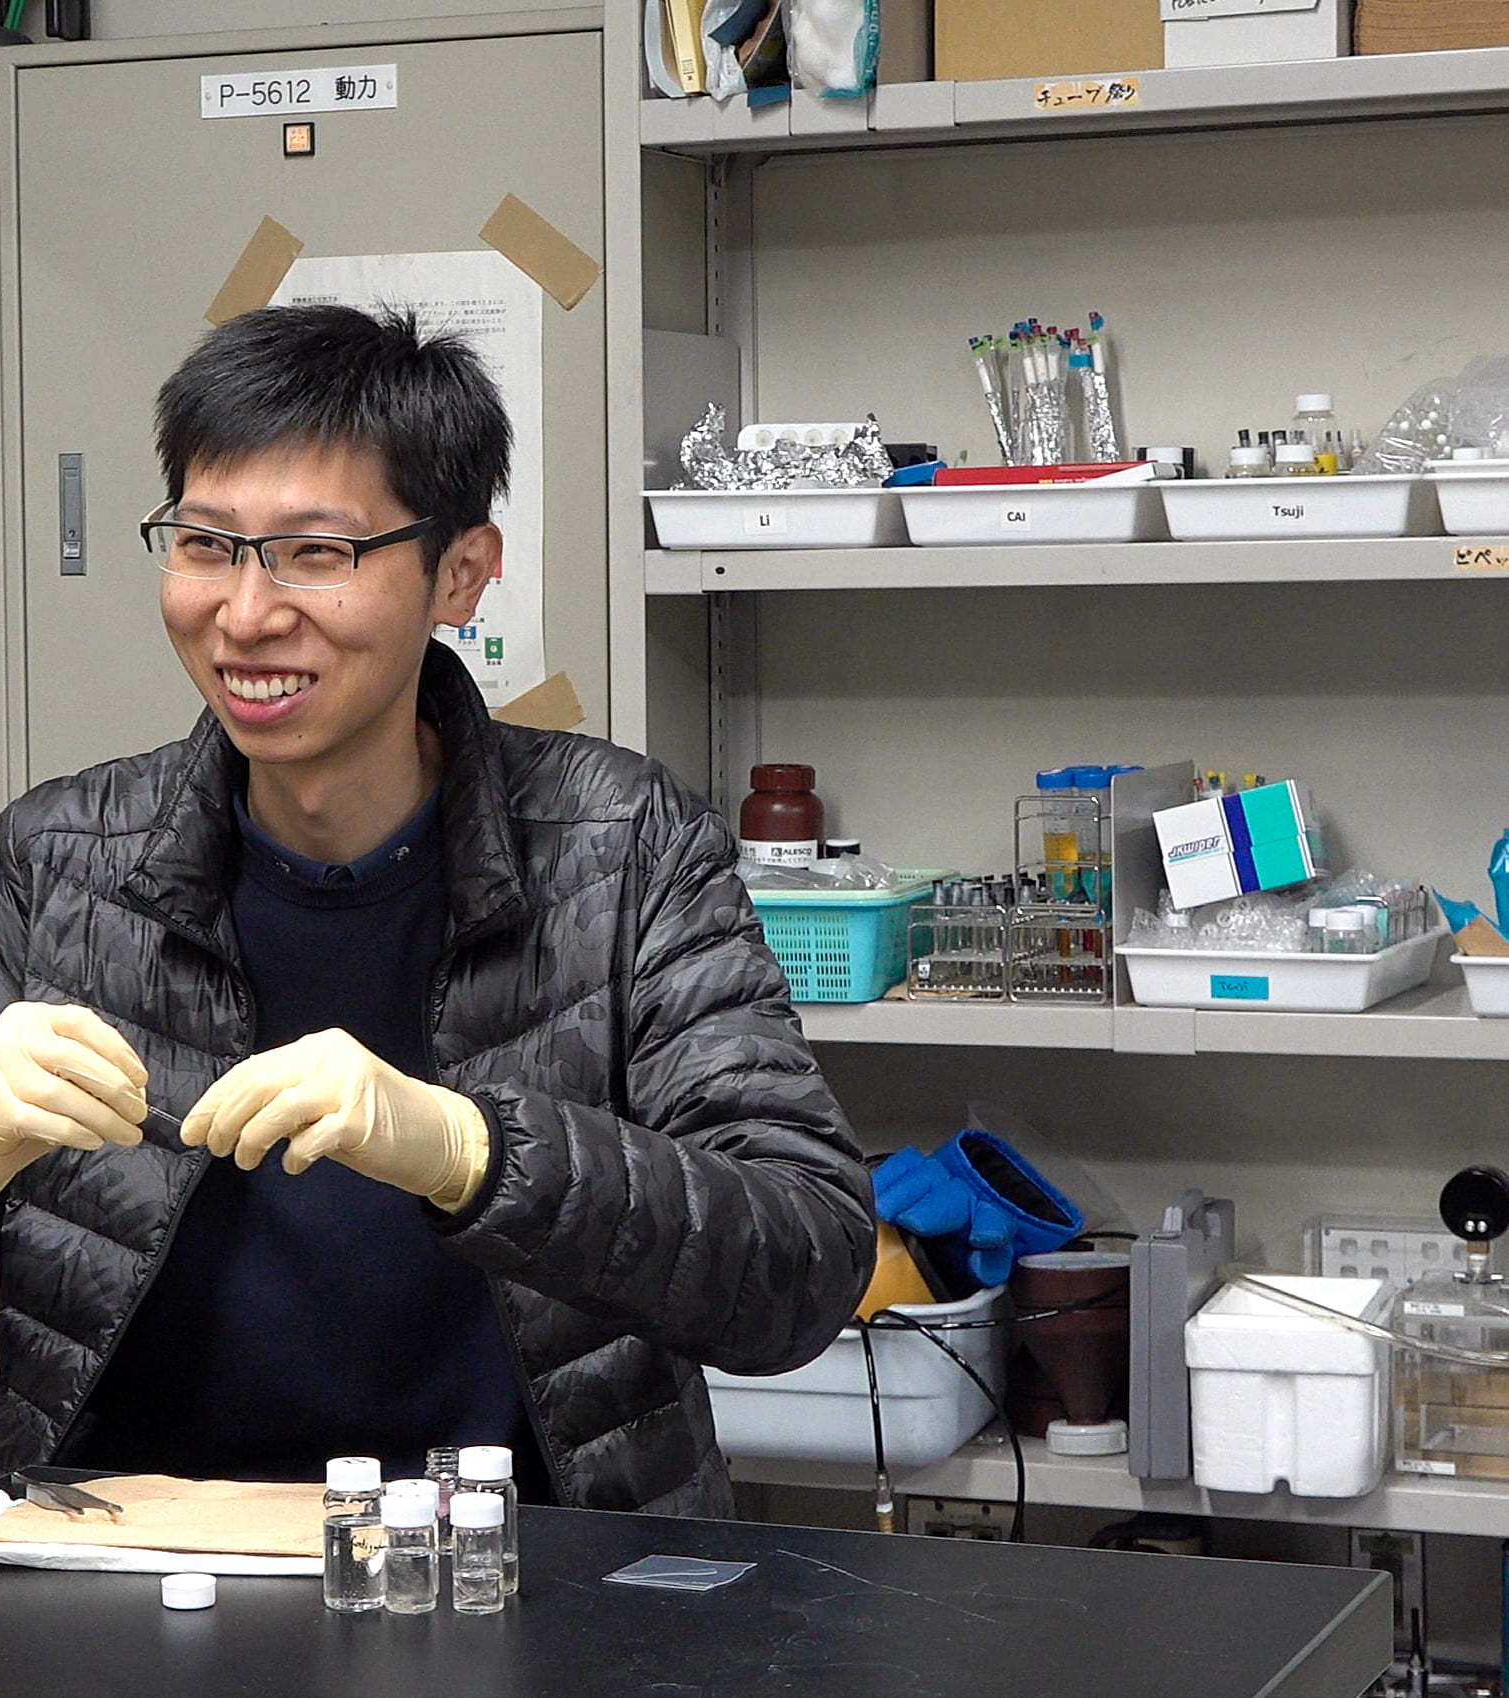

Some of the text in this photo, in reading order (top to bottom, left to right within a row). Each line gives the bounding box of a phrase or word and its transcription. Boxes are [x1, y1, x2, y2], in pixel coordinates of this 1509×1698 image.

[220, 75, 377, 107] P-5612 動力
[1272, 505, 1305, 519] Tsuji
[759, 515, 771, 527] Li
